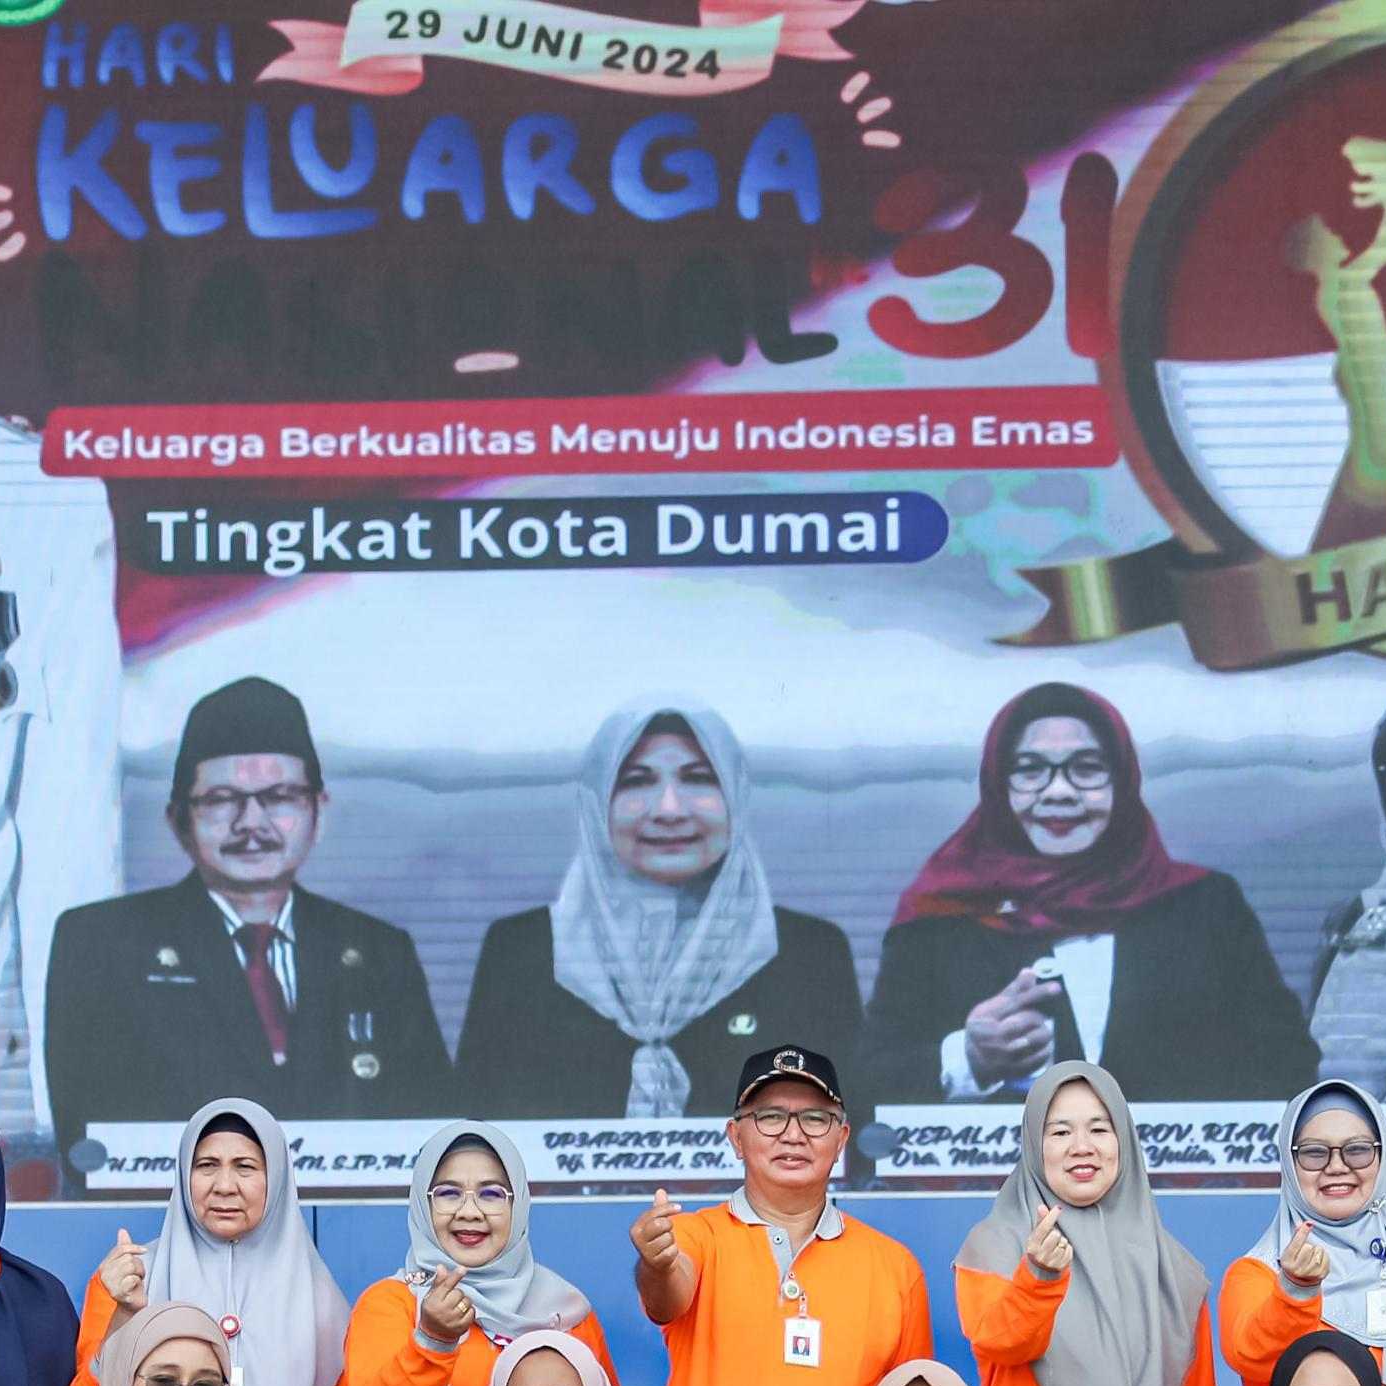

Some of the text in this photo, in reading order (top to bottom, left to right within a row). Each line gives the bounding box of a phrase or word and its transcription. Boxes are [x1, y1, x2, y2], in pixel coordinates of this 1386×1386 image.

[40, 20, 235, 90] HARI
[385, 8, 722, 80] 29 JUNI 2024
[37, 102, 823, 241] KELUARGA
[63, 414, 1095, 467] Keluarga Berkualitas Menuju Indonesia Emas
[146, 498, 901, 577] Tingkat Kota Dumai
[894, 1123, 1005, 1146] KEPALA
[1136, 1123, 1194, 1143] ROV.
[1201, 1123, 1279, 1143] RIAU
[1145, 1144, 1216, 1167] Yulia,
